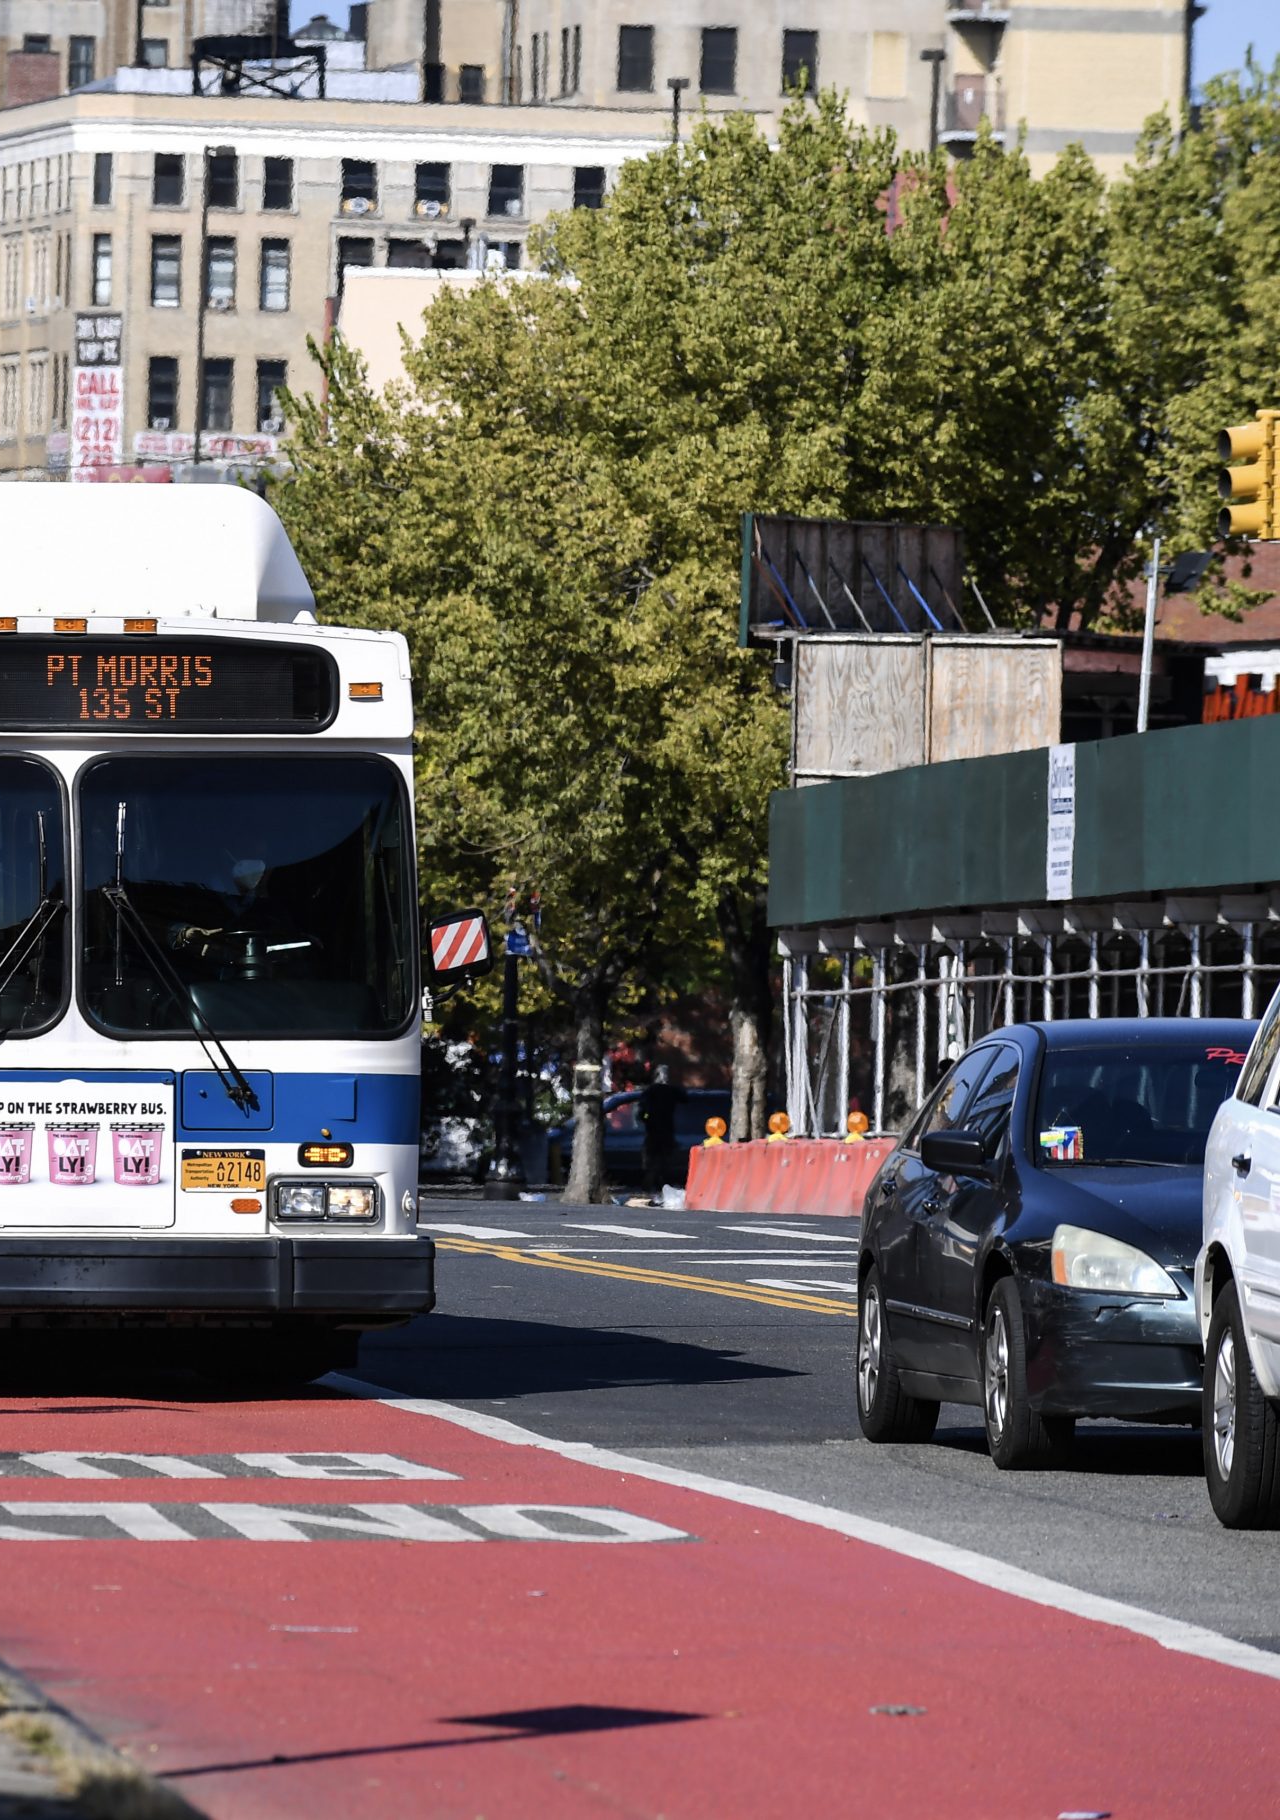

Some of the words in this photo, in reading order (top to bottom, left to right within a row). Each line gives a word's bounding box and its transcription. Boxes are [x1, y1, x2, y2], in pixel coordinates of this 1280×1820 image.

[78, 372, 119, 395] CALL
[47, 655, 82, 687] PT
[96, 655, 213, 687] MORRIS
[79, 688, 132, 719] 135
[144, 688, 180, 719] ST
[7, 1101, 25, 1114] ON
[28, 1101, 53, 1114] THE
[55, 1102, 137, 1115] STRAWBERRY
[140, 1102, 167, 1115] BUS.
[59, 1156, 85, 1173] LY!
[123, 1156, 150, 1173] LY!
